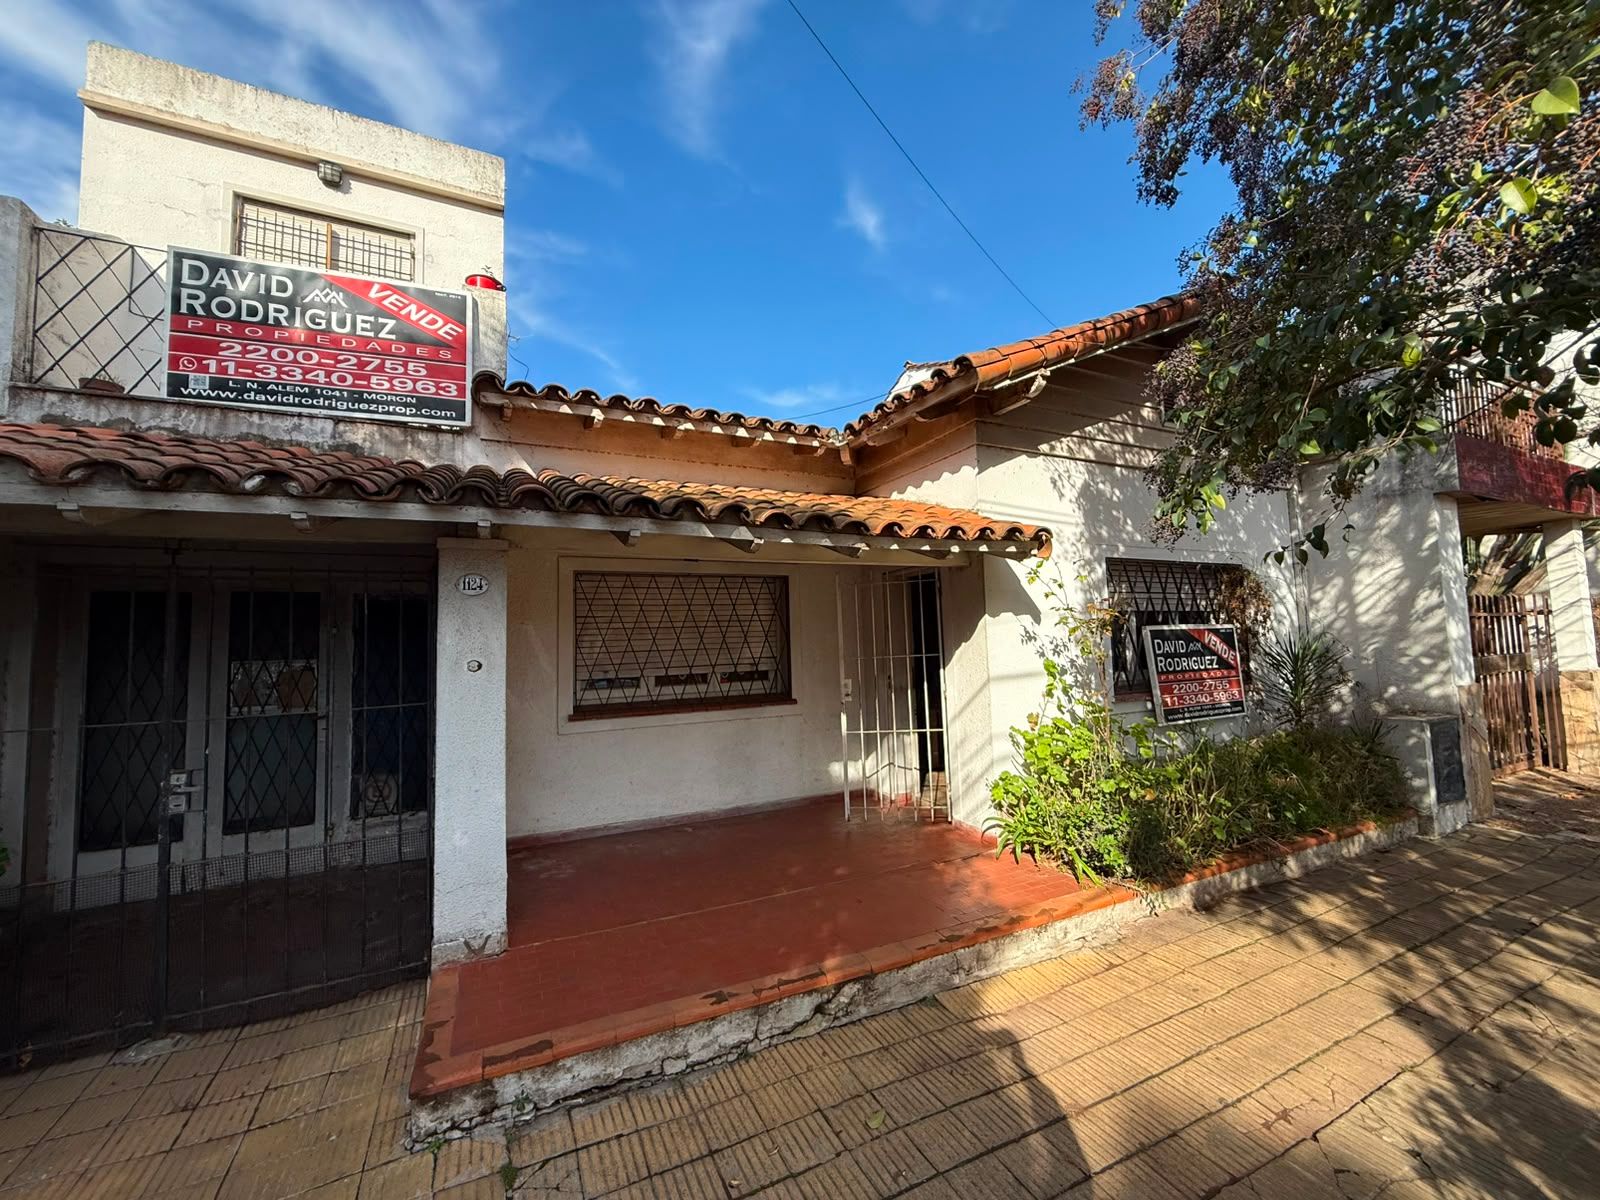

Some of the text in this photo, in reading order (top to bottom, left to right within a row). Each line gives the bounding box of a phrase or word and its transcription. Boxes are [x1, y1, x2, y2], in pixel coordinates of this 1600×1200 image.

[181, 258, 294, 298] DAVID
[179, 288, 397, 340] RODRIGUEZ
[367, 282, 464, 341] VENDE
[187, 319, 453, 360] PROPIEDADES
[217, 342, 428, 377] 2200-2755
[201, 358, 459, 397] 11-3340-5963
[228, 380, 240, 388] L.
[246, 381, 261, 390] N.
[266, 383, 309, 394] ALEM
[315, 388, 348, 398] 1041
[363, 392, 417, 404] MORON
[180, 387, 456, 418] www.davidrodriguezprop.com
[462, 577, 483, 591] 1124
[1154, 639, 1187, 654] DAVID
[1204, 630, 1236, 664] VENDE
[1157, 655, 1219, 672] RODRIGUEZ
[1165, 690, 1239, 707] 11-3340-5963
[1172, 680, 1230, 694] 2200-2755
